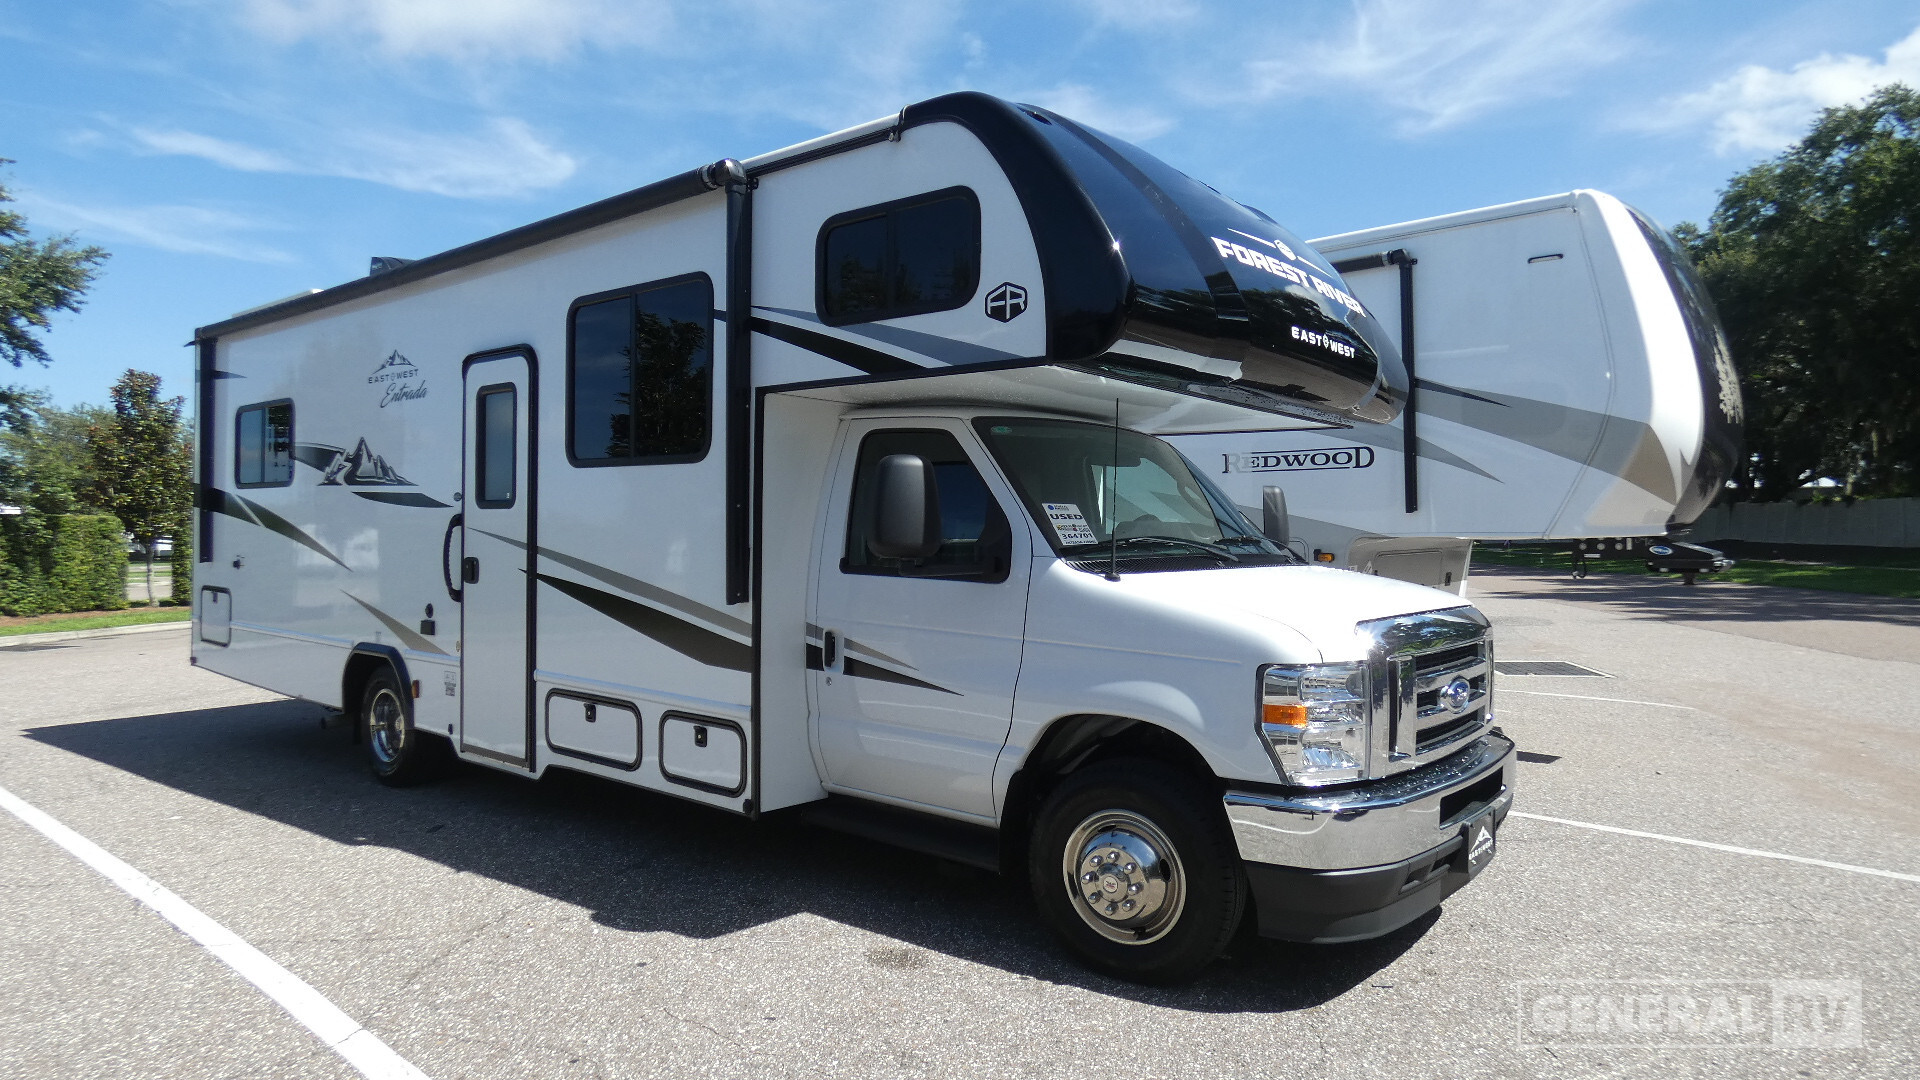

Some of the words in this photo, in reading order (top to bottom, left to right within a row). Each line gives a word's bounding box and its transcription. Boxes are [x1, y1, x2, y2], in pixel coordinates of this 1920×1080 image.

[1210, 236, 1310, 288] FOREST
[1309, 274, 1367, 318] RIVER
[1291, 326, 1322, 347] EAST
[1330, 341, 1356, 359] WEST
[368, 374, 390, 384] EAST
[397, 368, 419, 379] WEST
[380, 379, 428, 408] Entrada
[1222, 446, 1375, 474] REDWOOD
